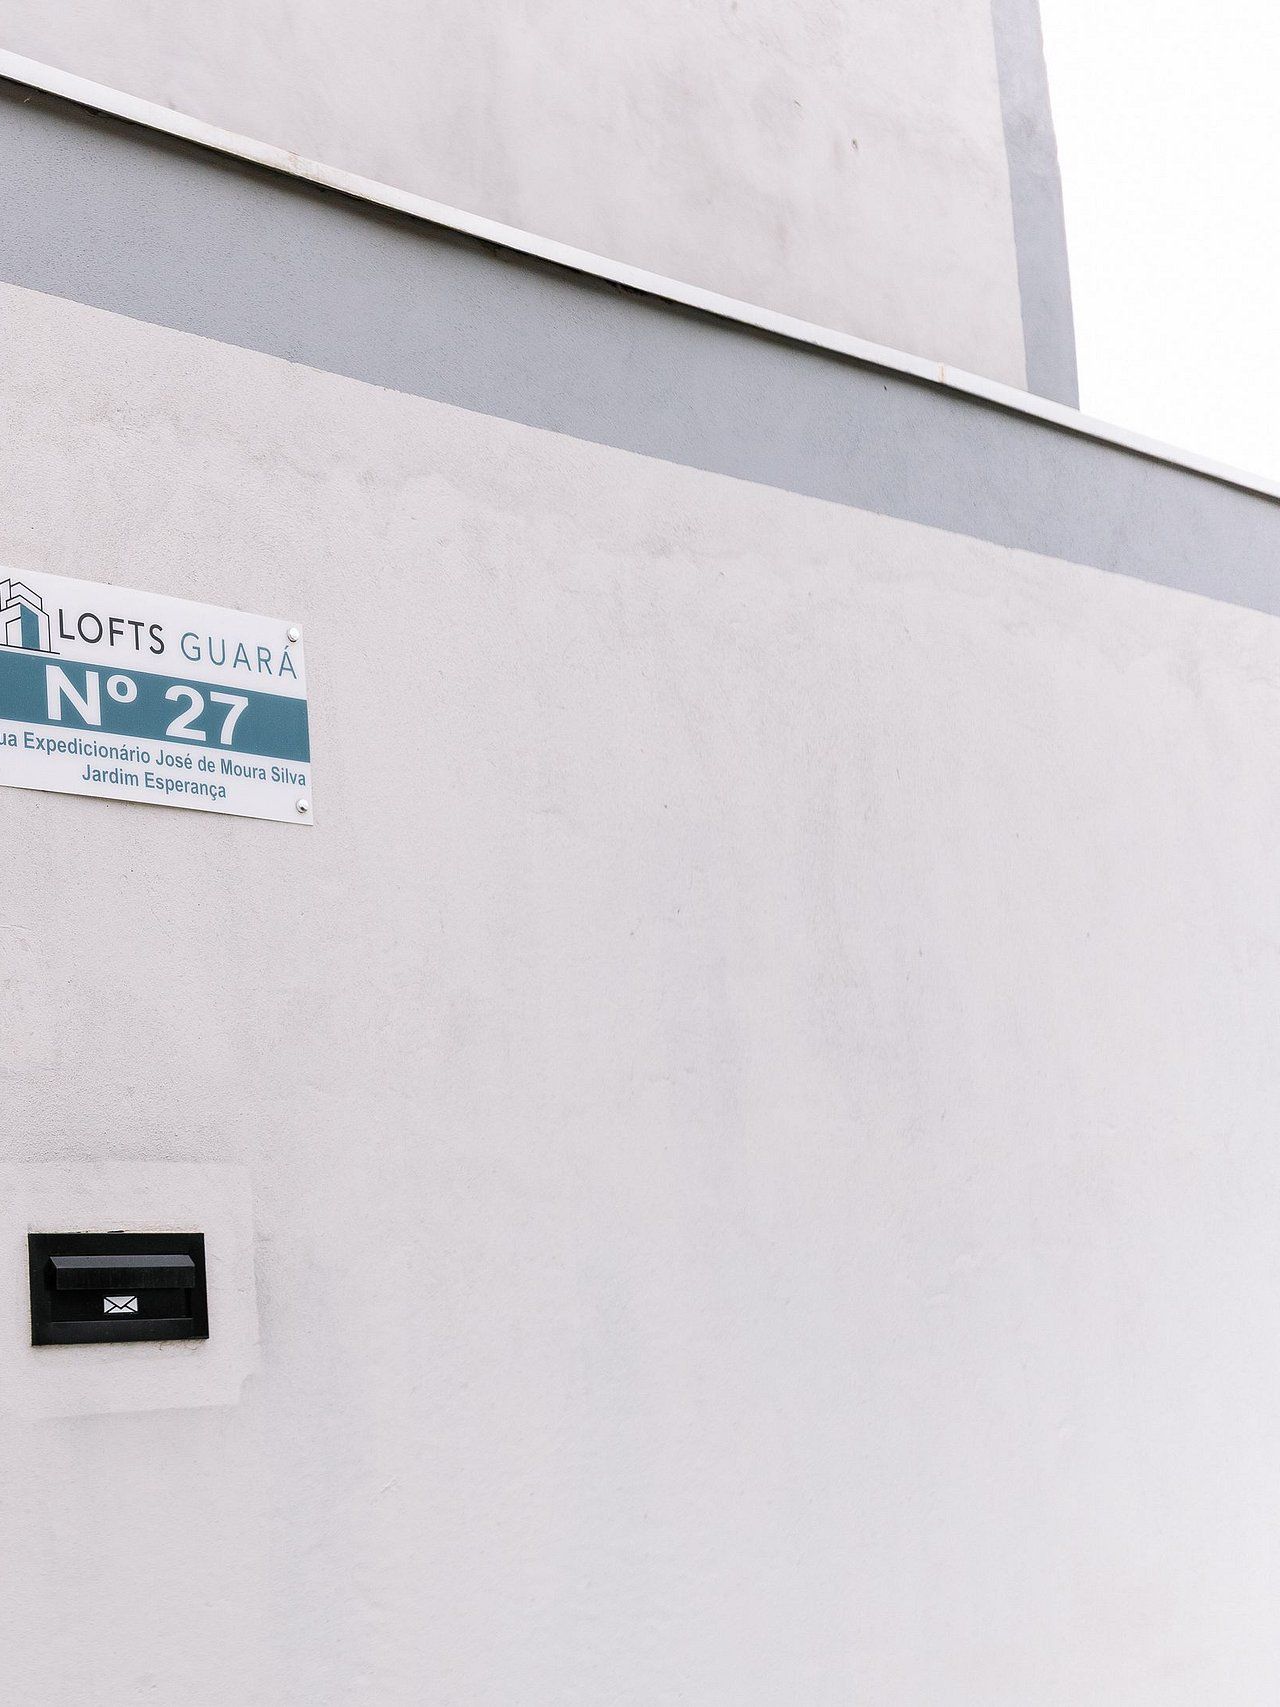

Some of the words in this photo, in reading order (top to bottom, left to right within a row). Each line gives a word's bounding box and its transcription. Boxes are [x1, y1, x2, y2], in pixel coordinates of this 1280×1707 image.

[58, 608, 165, 655] LOFTS
[180, 632, 298, 680] GUARÁ
[45, 664, 138, 727] Nº
[164, 685, 249, 746] 27
[24, 731, 151, 764] Expedicionário
[155, 749, 193, 770] José
[198, 755, 216, 772] de
[220, 760, 266, 781] Moura
[271, 766, 306, 787] Silva
[82, 764, 140, 788] Jardim
[144, 772, 227, 801] Esperança
